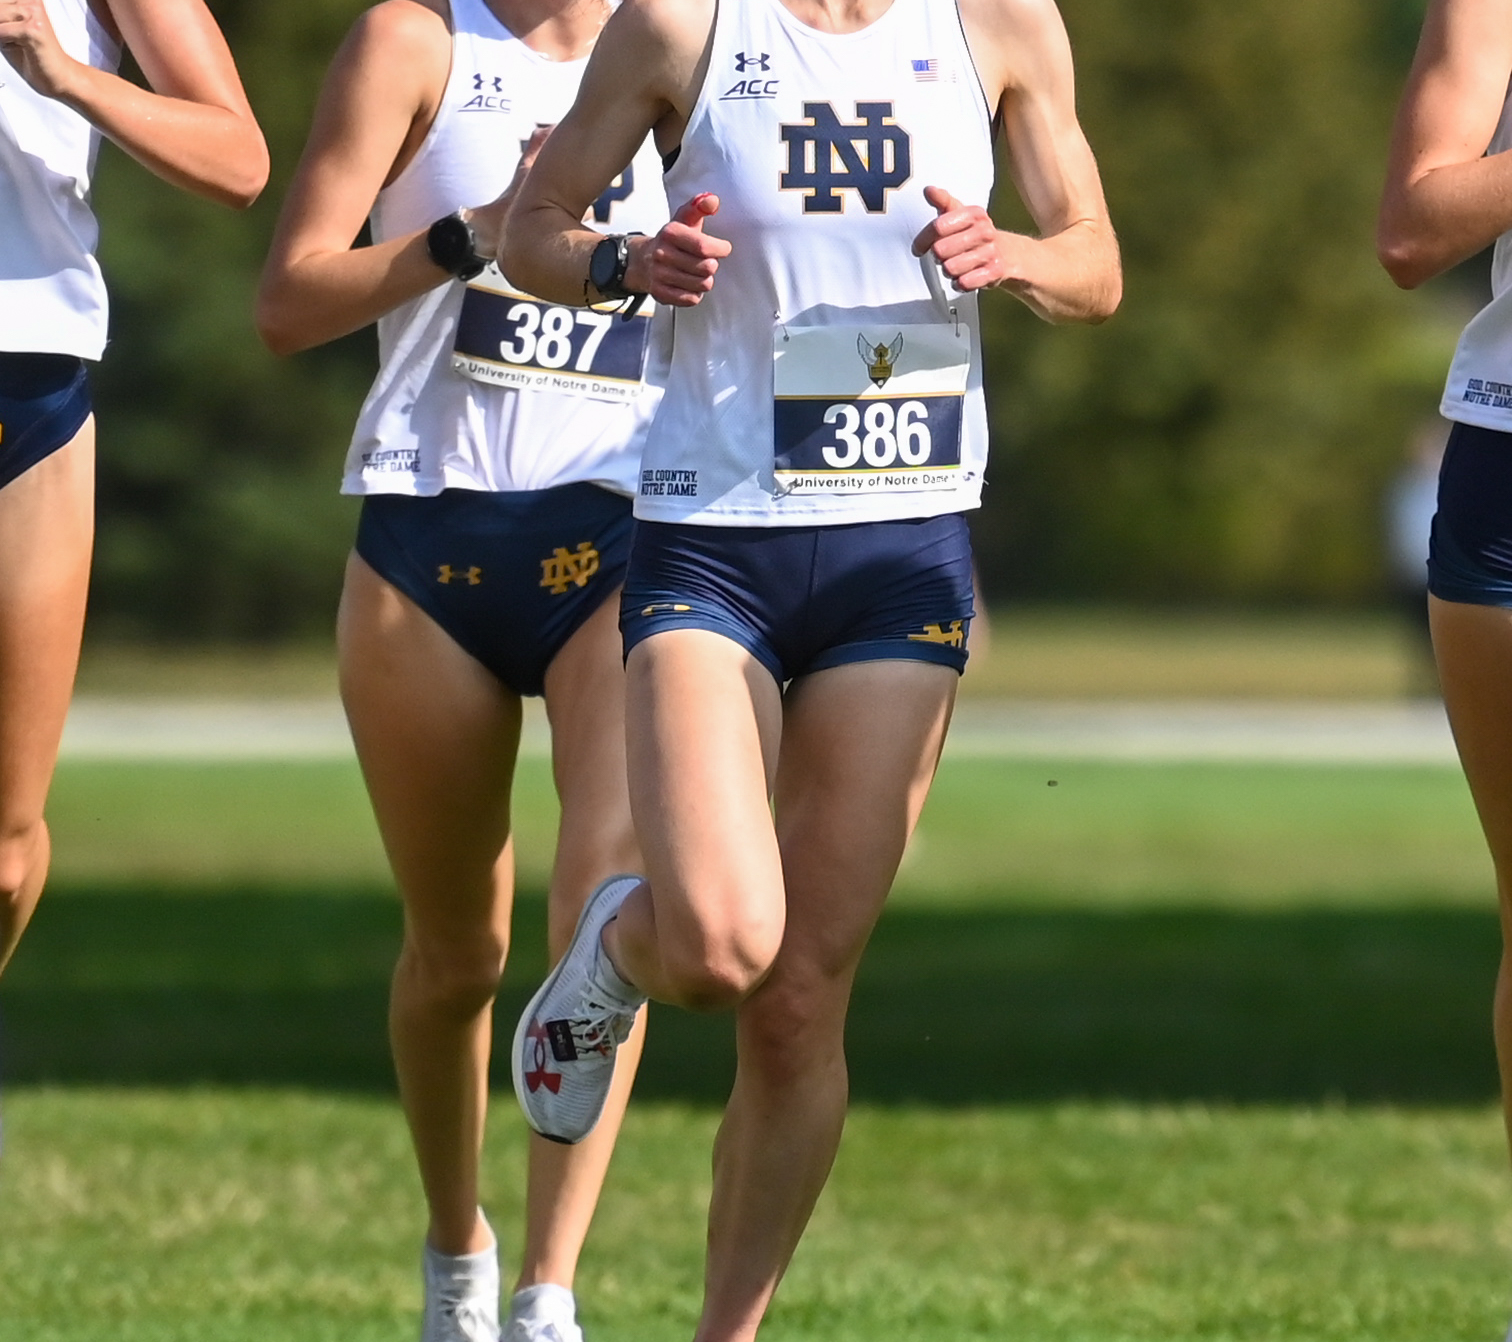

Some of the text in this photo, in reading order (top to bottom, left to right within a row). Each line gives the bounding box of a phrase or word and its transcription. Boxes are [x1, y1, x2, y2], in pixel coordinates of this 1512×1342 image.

[723, 79, 780, 96] ACC
[463, 94, 512, 111] ACC
[499, 301, 614, 372] 387
[467, 361, 626, 397] University of Notre Dame
[821, 399, 932, 469] 386
[666, 482, 698, 497] DAME
[795, 473, 949, 489] University of Notre Dame
